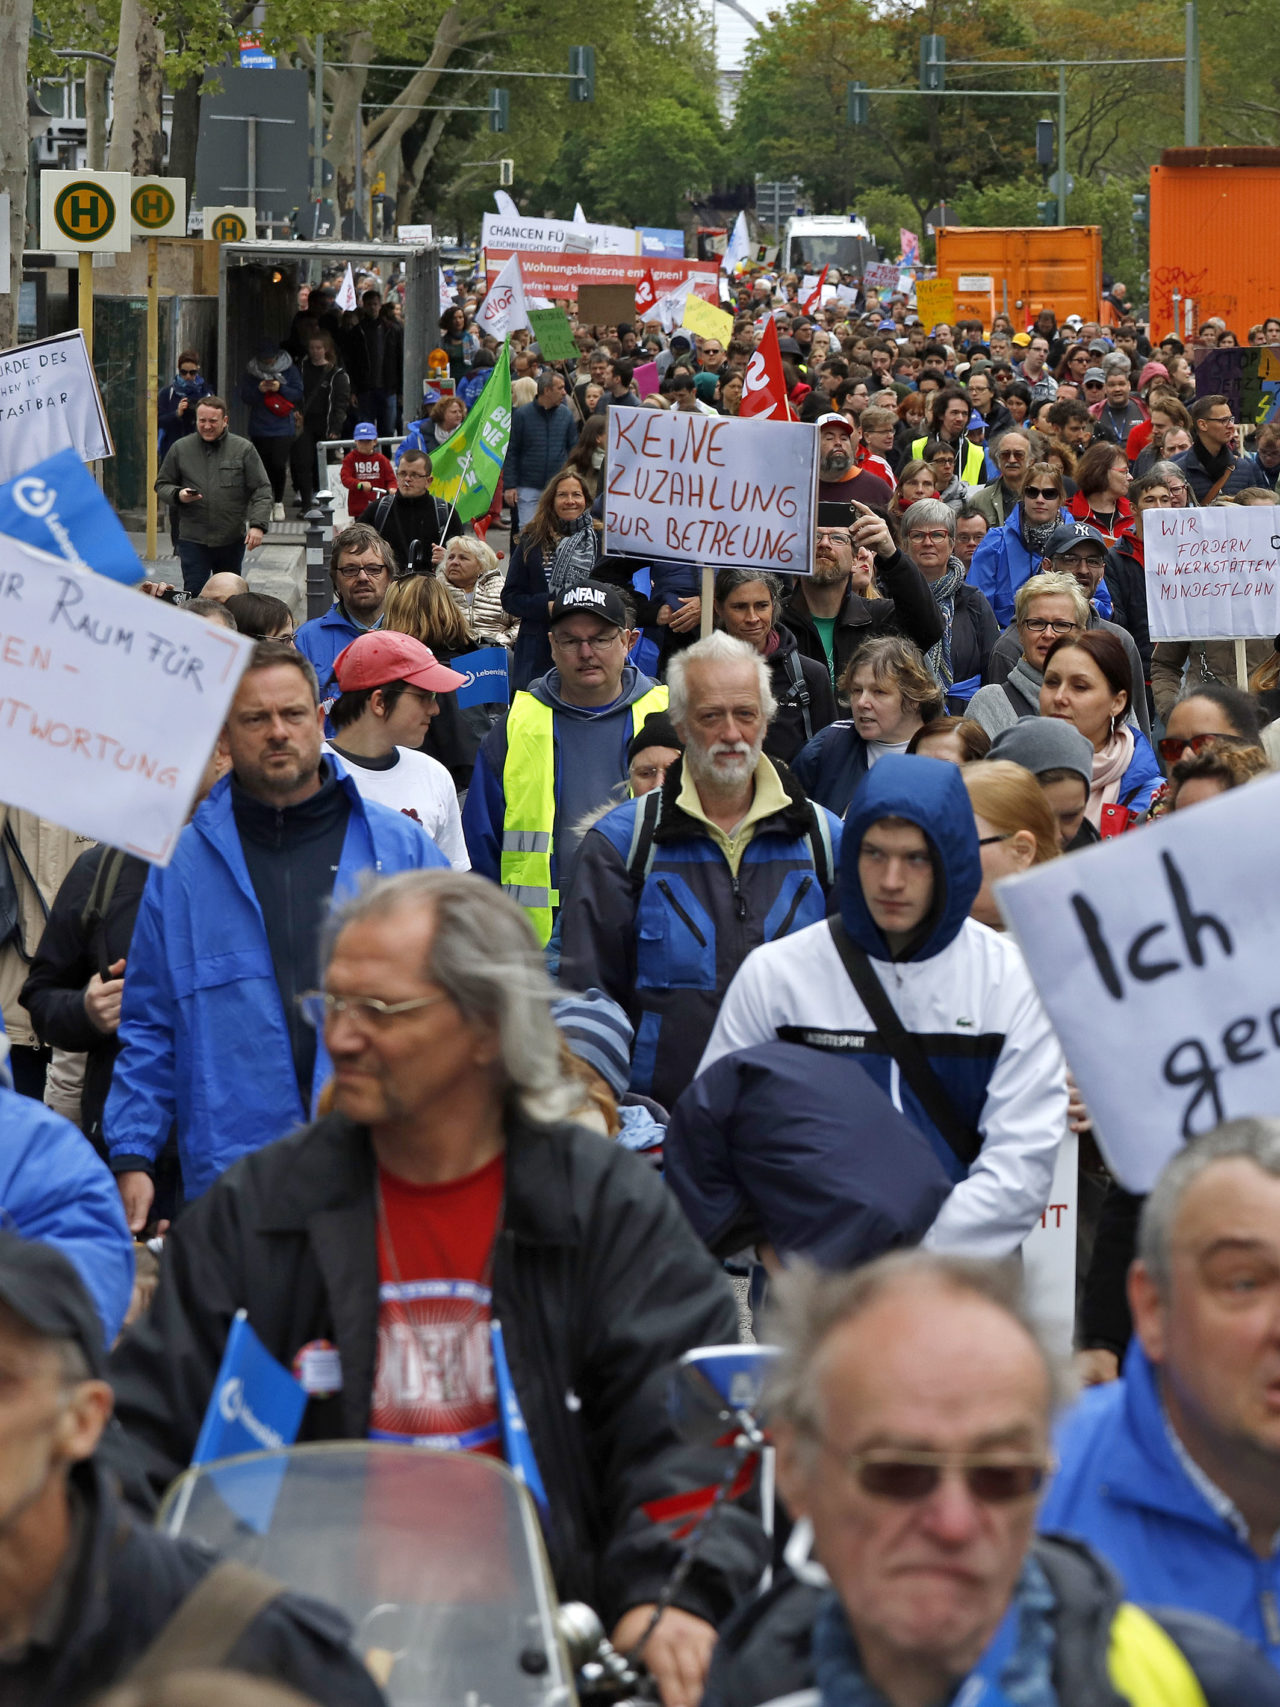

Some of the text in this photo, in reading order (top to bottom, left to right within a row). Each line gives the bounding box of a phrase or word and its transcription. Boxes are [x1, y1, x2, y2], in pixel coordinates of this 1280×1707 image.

[71, 196, 98, 227] H
[142, 195, 162, 218] H
[489, 225, 565, 243] CHANCEN FÜ
[522, 262, 625, 278] Wohnungskonzerne
[627, 269, 683, 280] entignen!
[552, 283, 570, 292] und
[39, 352, 68, 367] DES
[355, 461, 380, 473] 1984
[608, 463, 798, 518] ZUZAHLUNG
[606, 511, 798, 562] ZUR BETREUNG
[1161, 517, 1199, 537] WIR
[1177, 538, 1252, 557] FORDERN
[1174, 557, 1277, 577] WERKSTÄTTEN
[563, 587, 607, 607] UNFAIR
[146, 631, 206, 693] FÜR
[0, 697, 180, 790] TWORTUNG
[1070, 849, 1234, 1001] Ich
